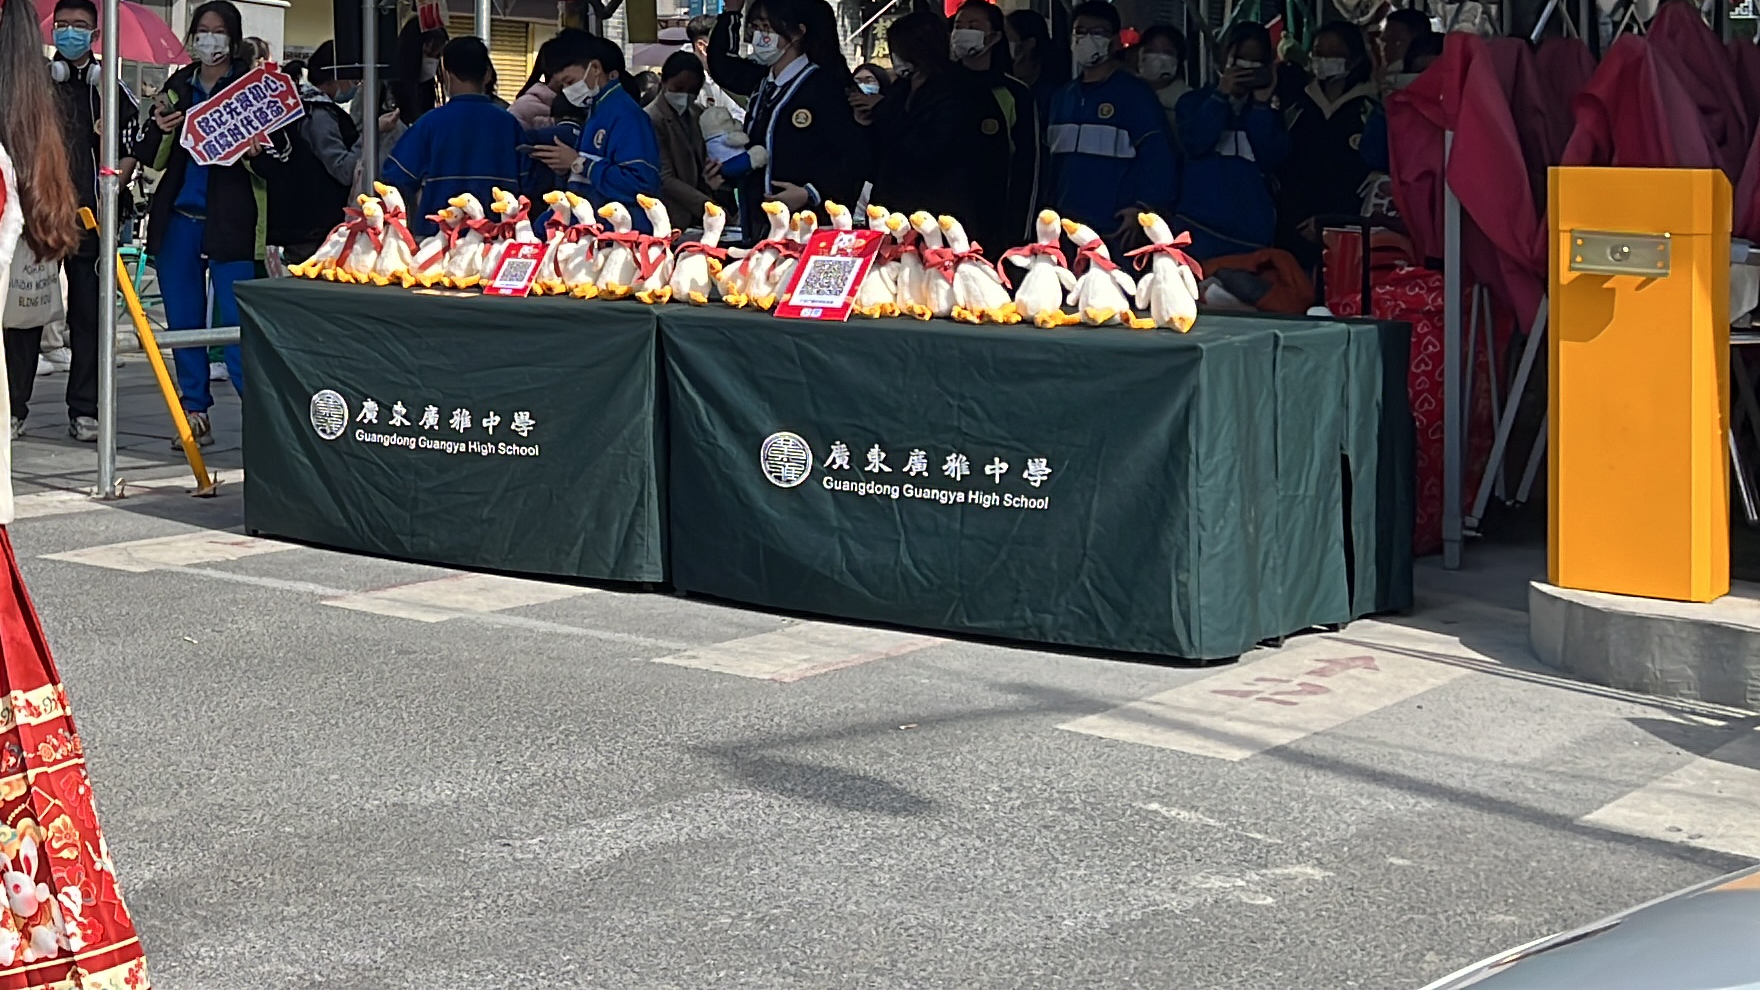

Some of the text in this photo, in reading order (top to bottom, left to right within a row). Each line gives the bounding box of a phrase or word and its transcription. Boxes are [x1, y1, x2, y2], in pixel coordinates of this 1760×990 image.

[355, 429, 540, 457] Guangdong Guangya High School
[822, 475, 1050, 510] Guangdong Guangya High School
